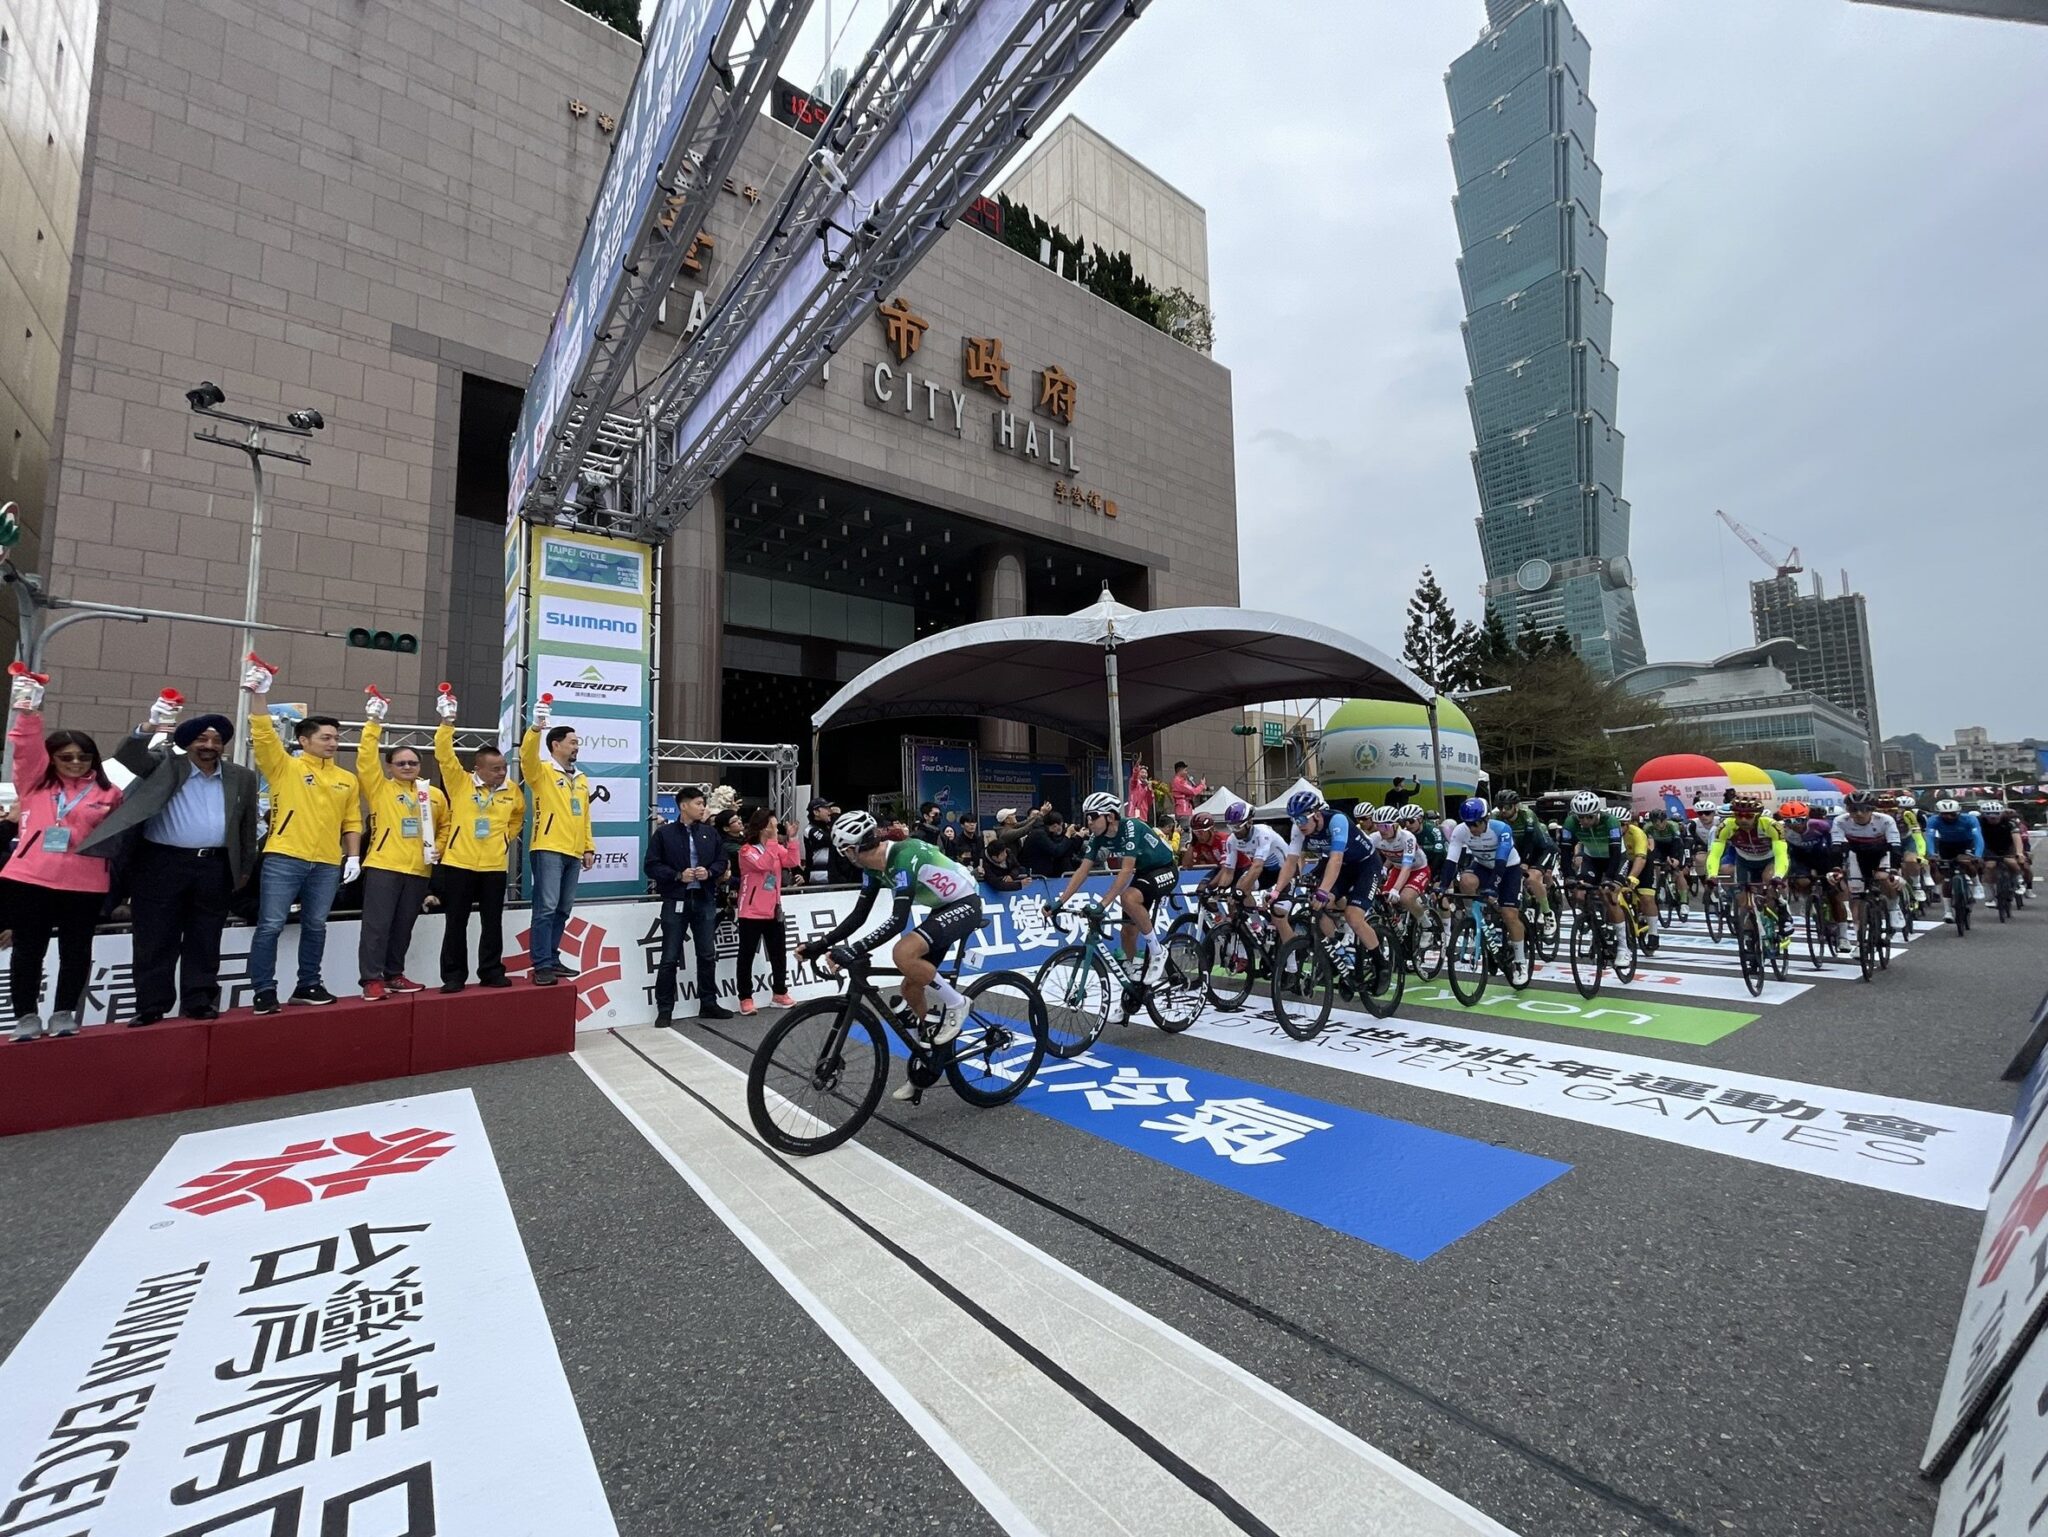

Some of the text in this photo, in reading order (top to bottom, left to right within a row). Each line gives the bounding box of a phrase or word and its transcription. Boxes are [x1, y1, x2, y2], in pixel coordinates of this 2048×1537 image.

[874, 362, 1080, 474] CITY HALL
[548, 544, 577, 557] TAIPEI
[579, 550, 608, 562] CYCLE
[546, 611, 638, 634] SHIMANO
[552, 679, 628, 693] MERIDA
[1390, 742, 1454, 761] 教育部
[921, 764, 935, 772] Tour
[945, 765, 965, 773] Taiwan
[1154, 871, 1175, 884] KERN
[935, 903, 972, 923] VICTORIA
[939, 908, 976, 928] SPORTS
[1096, 942, 1131, 983] GIANT
[1321, 936, 1350, 977] FACTOR
[1090, 976, 1110, 1042] CADEX
[1562, 1084, 1926, 1166] GAMES
[76, 1260, 211, 1392] TAIWAN
